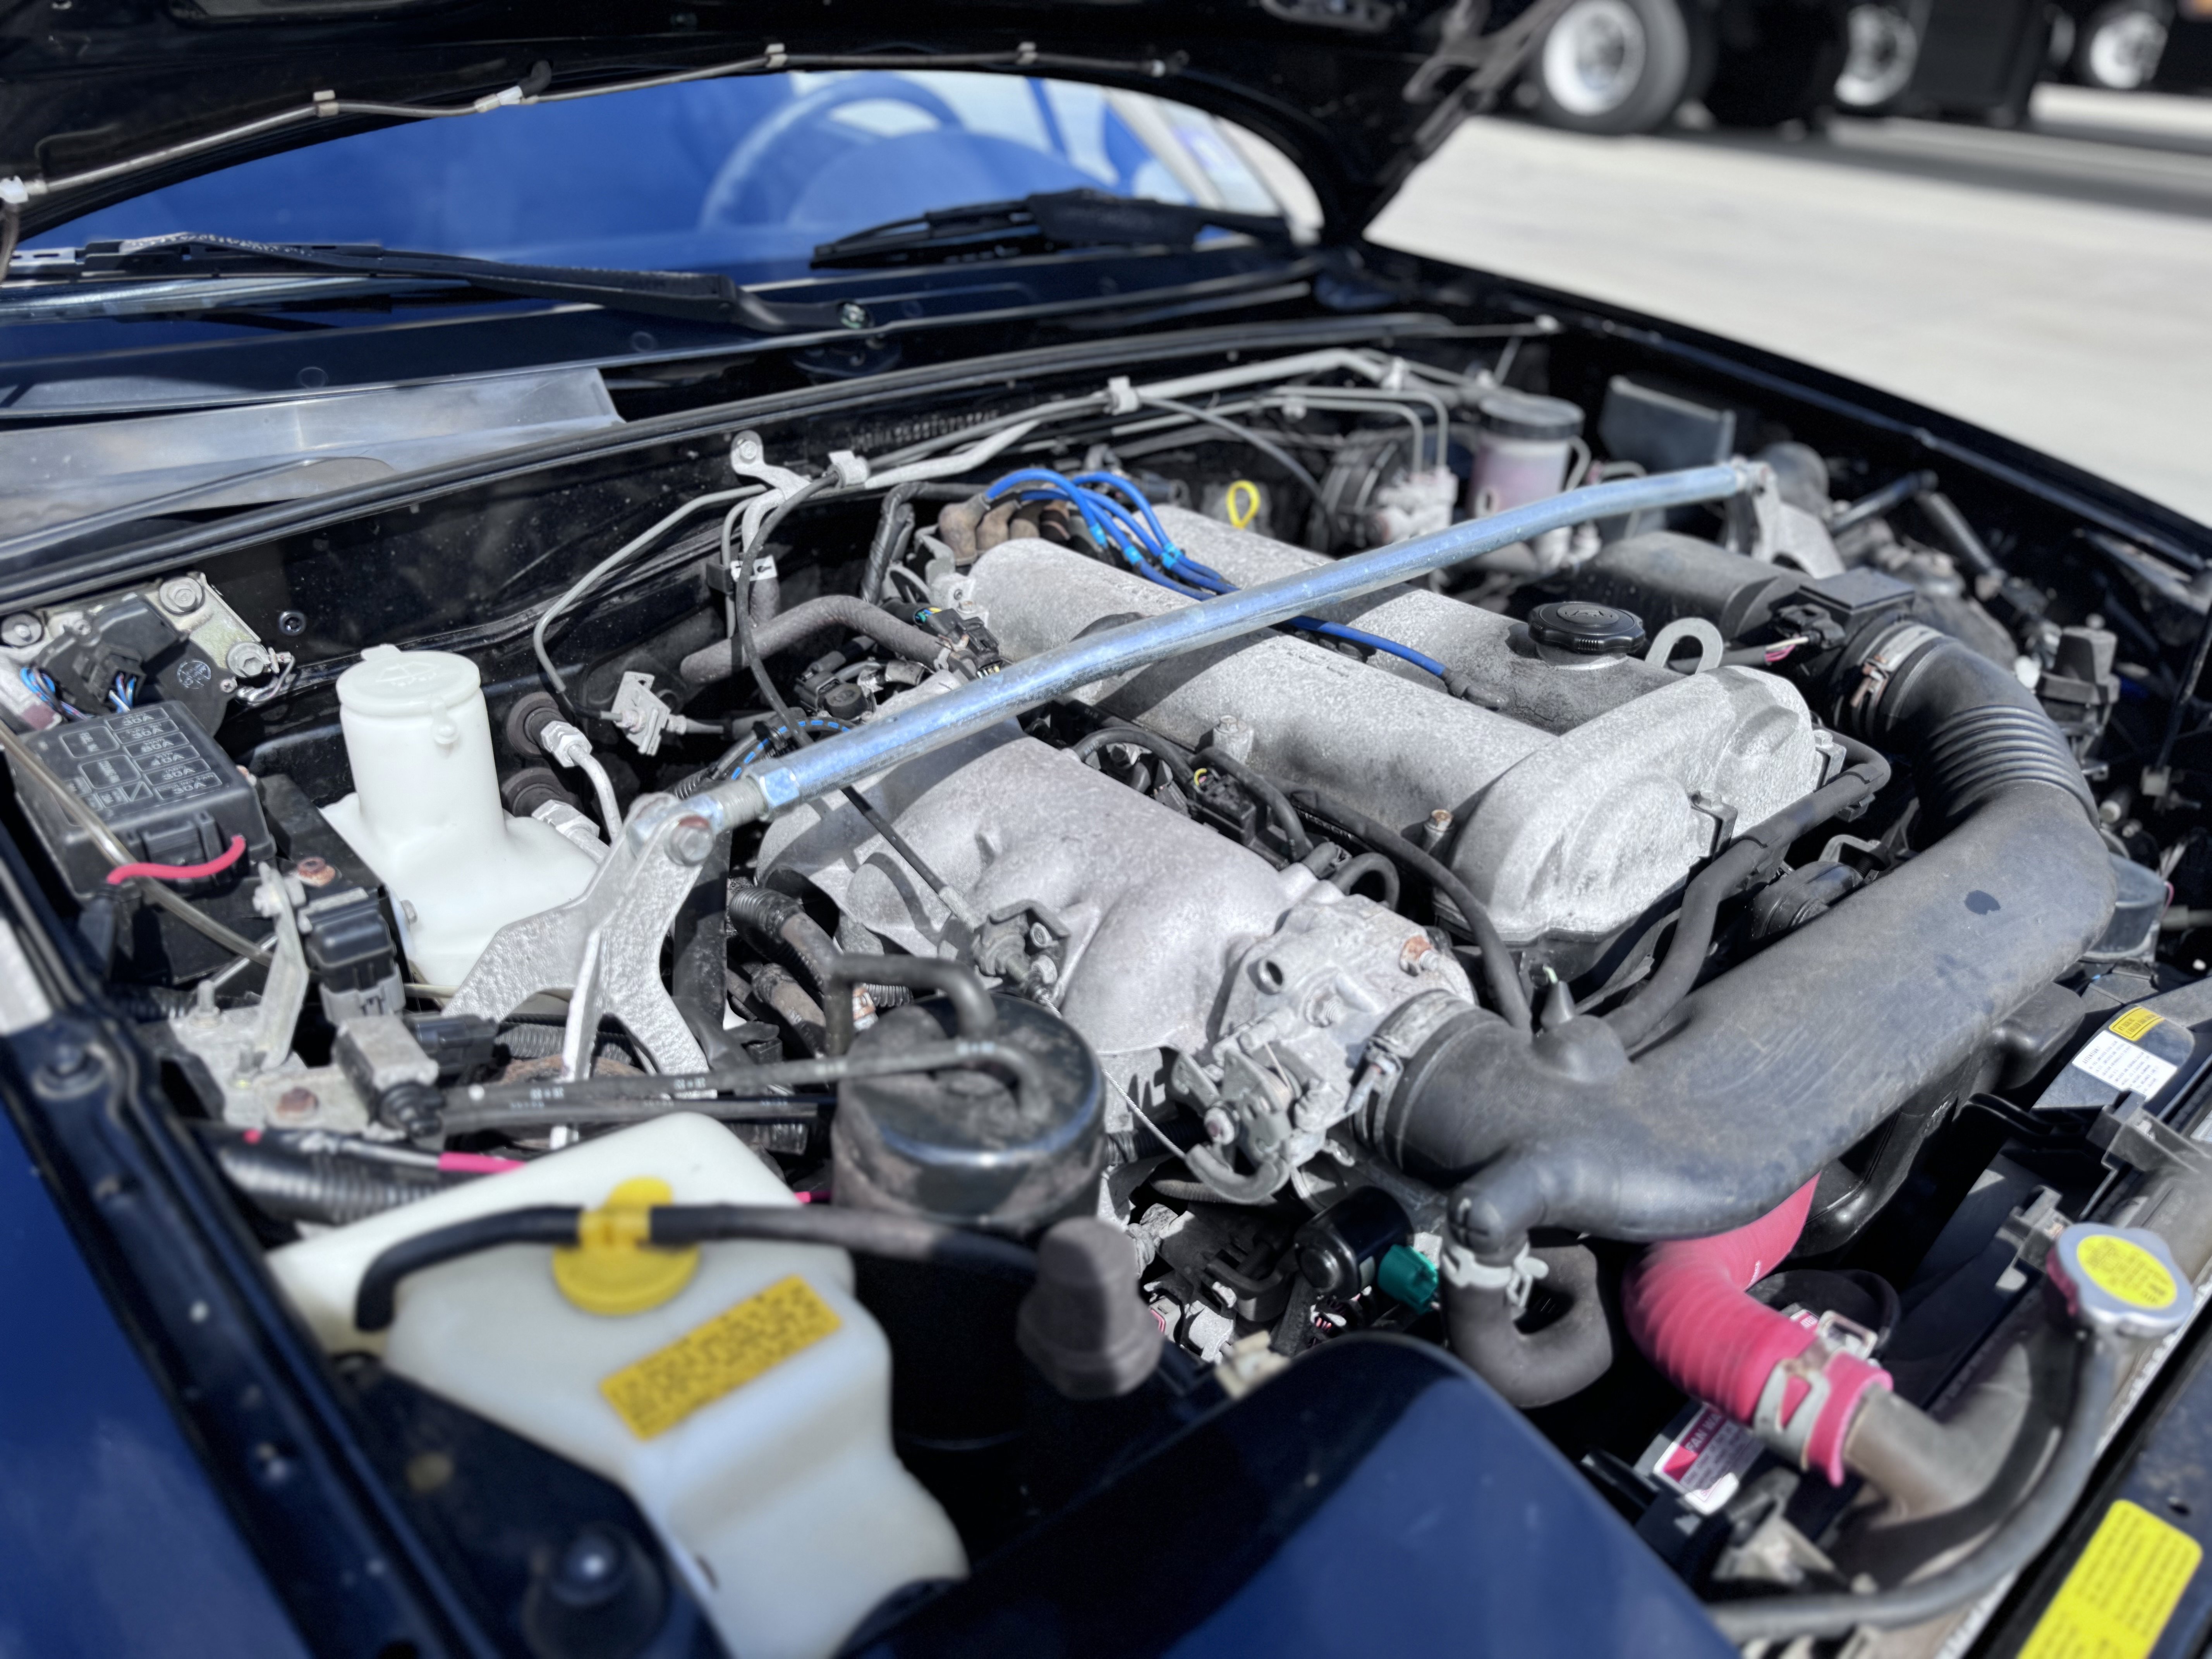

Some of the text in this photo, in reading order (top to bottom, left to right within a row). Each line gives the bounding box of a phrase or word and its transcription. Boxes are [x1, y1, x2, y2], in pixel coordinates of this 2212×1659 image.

[123, 716, 154, 726] 30A
[132, 727, 164, 738] 30A
[162, 768, 196, 780] 30A
[173, 781, 206, 794] 30A
[1685, 1431, 1706, 1452] FAN
